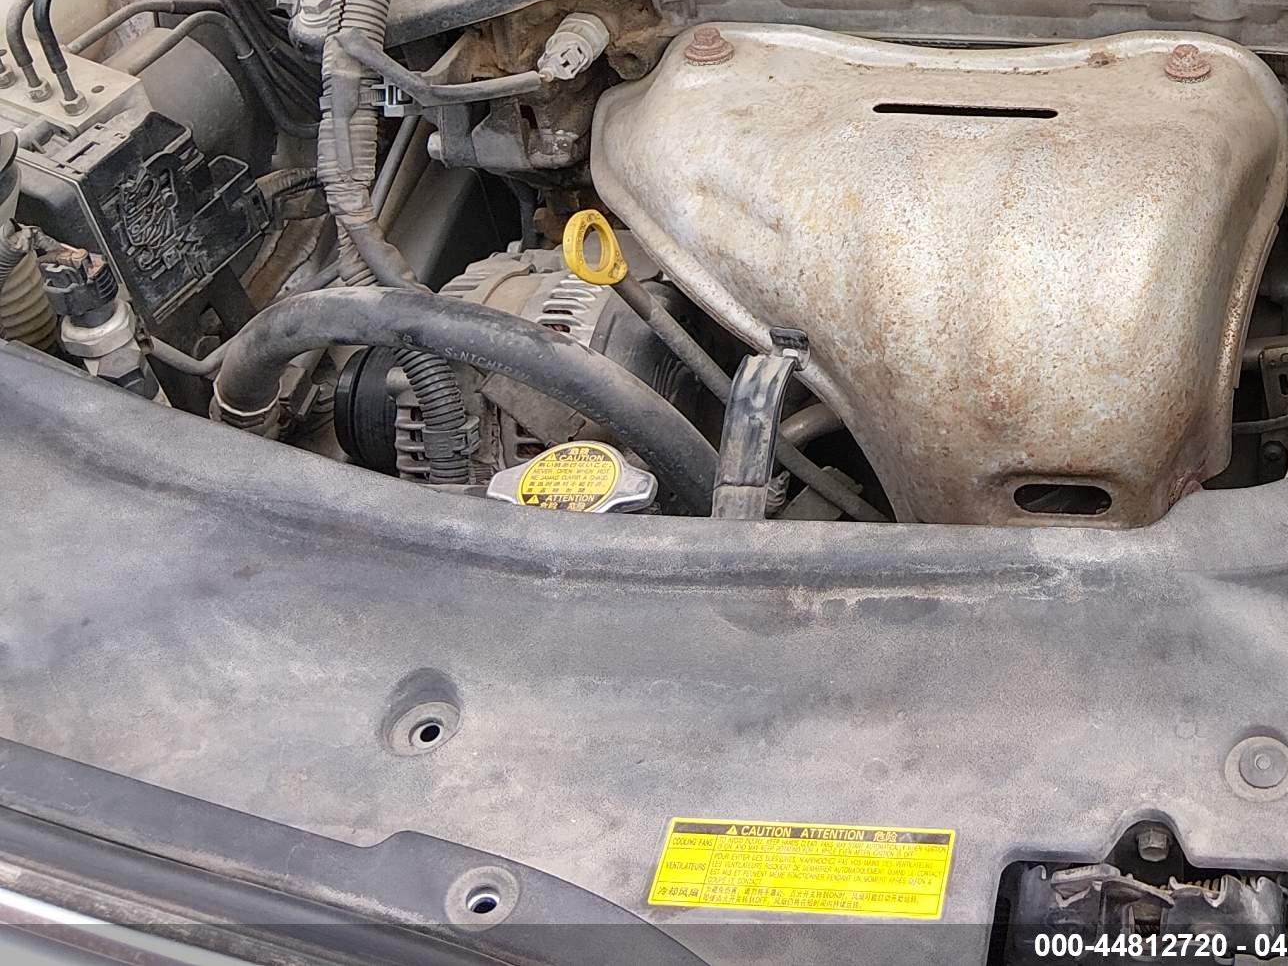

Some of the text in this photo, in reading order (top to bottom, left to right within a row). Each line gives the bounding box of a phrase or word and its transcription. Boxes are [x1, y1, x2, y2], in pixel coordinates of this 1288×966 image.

[559, 454, 605, 462] CAUTION
[741, 825, 865, 841] CAUTION ATTENTION
[698, 838, 713, 847] FANS
